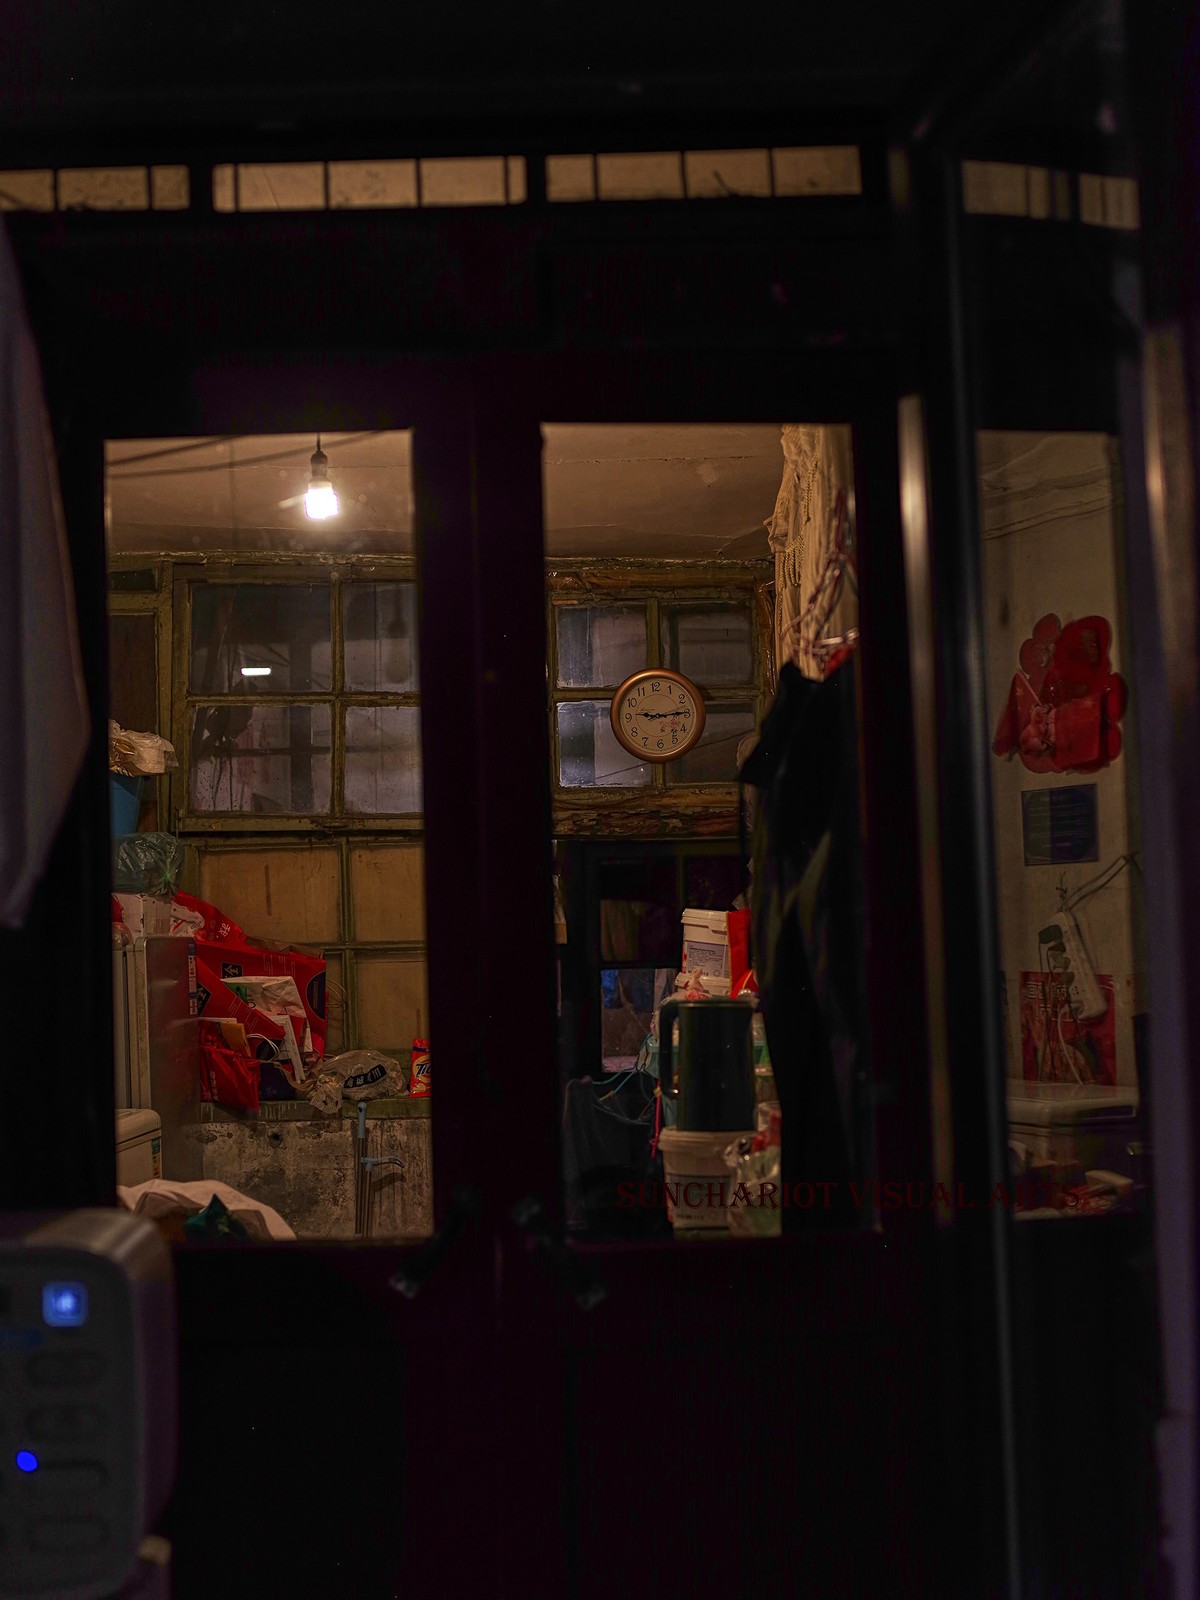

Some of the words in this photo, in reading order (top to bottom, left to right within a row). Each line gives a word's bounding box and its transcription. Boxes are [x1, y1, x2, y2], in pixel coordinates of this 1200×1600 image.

[651, 681, 661, 692] 12
[667, 685, 672, 694] 1
[637, 687, 646, 697] 11
[627, 697, 637, 708] 10
[678, 694, 686, 704] 2
[625, 712, 632, 722] 9
[683, 708, 691, 718] 3
[631, 727, 638, 737] 8
[680, 724, 687, 733] 4
[642, 736, 649, 746] 7
[657, 739, 664, 749] 6
[671, 734, 679, 744] 5
